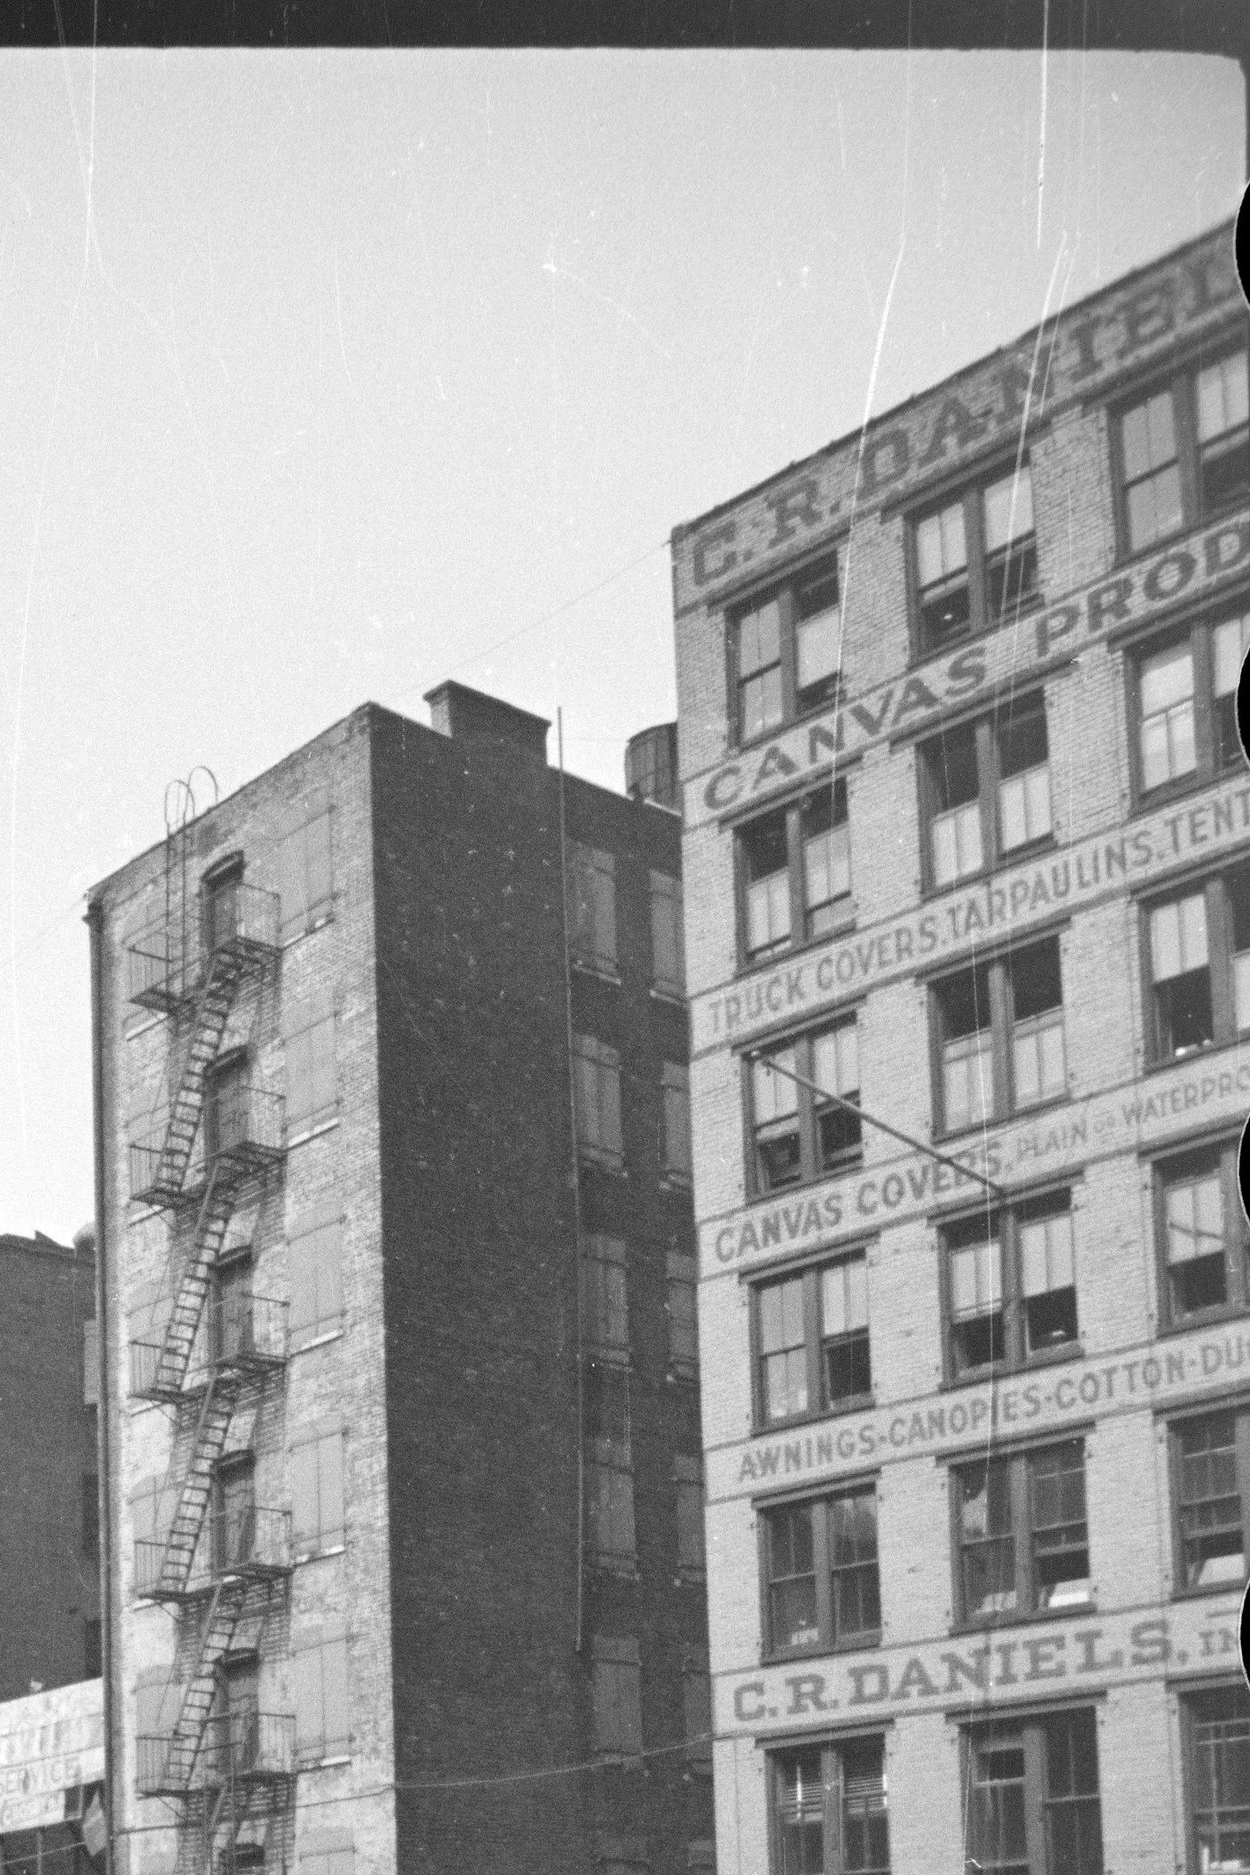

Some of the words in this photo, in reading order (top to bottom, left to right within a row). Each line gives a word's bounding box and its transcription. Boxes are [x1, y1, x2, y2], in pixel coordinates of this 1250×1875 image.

[704, 648, 988, 811] CANVAS
[709, 970, 803, 1033] TRUCK
[715, 1191, 843, 1263] CANVAS
[1015, 1118, 1088, 1159] PLAIN
[1201, 1336, 1250, 1375] DU
